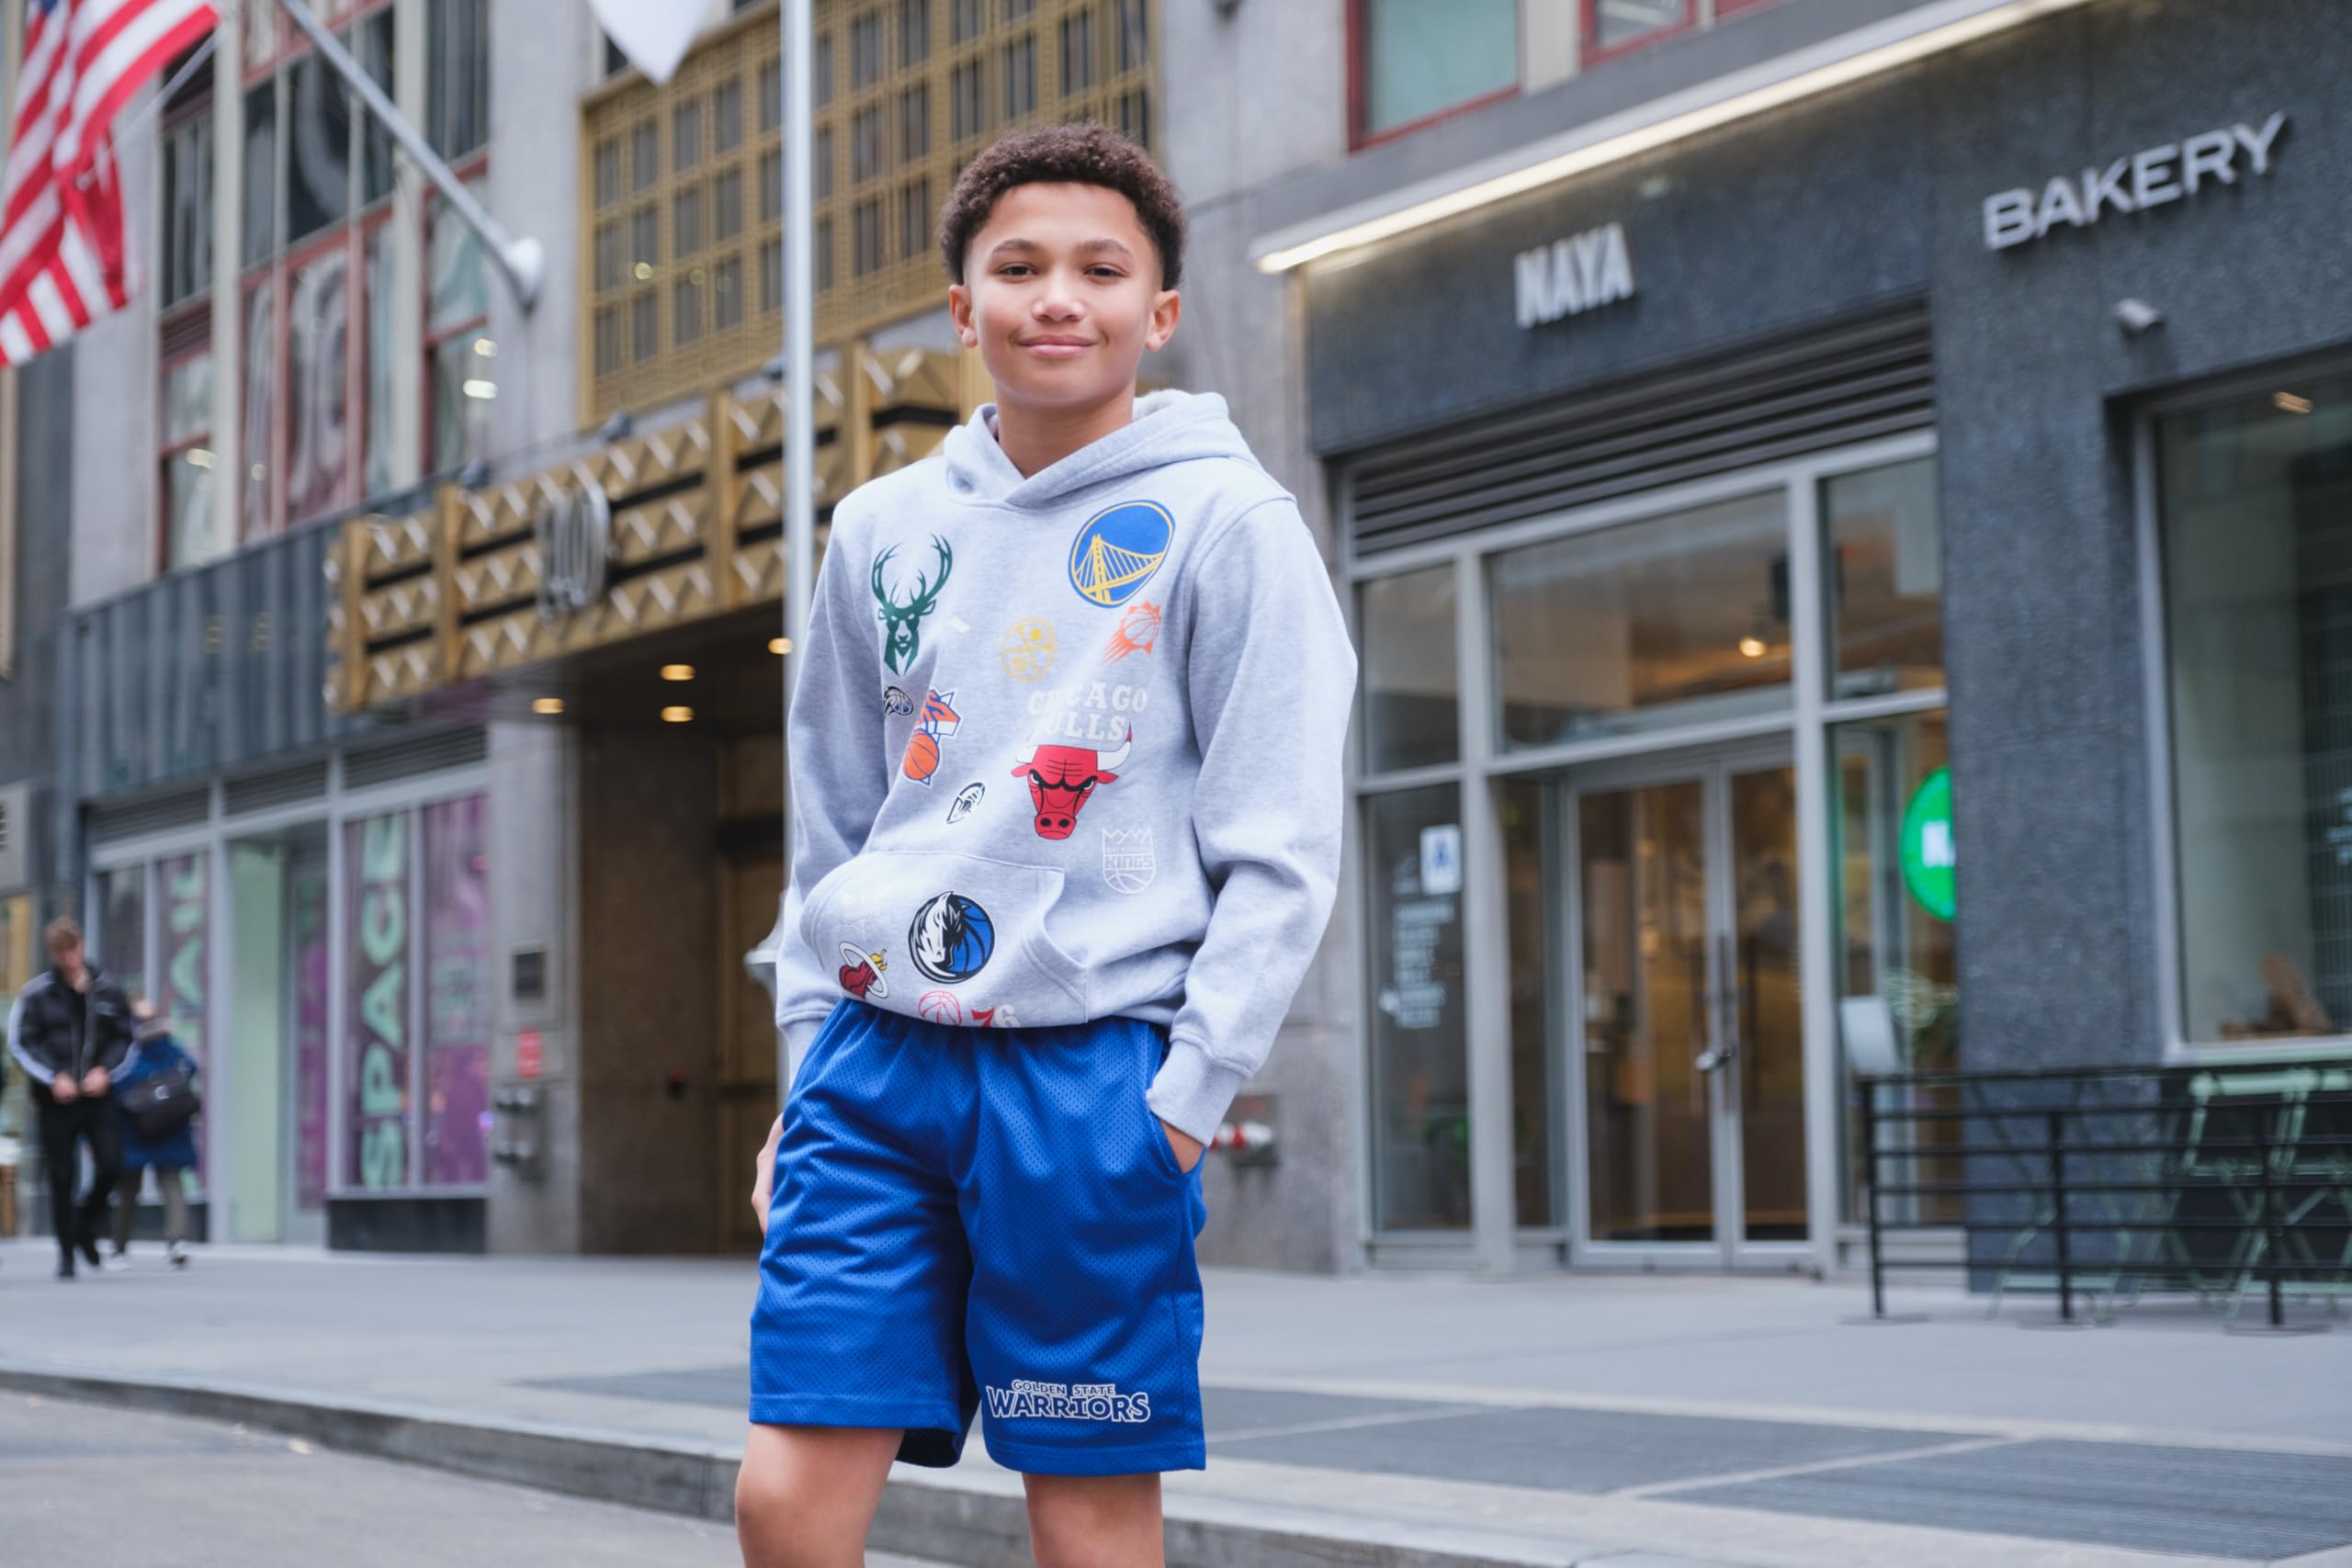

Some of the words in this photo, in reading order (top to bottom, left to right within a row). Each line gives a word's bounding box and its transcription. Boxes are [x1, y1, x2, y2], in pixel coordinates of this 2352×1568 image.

[1982, 110, 2286, 250] BAKERY
[1034, 710, 1126, 742] ULLS
[361, 813, 404, 1190] SPACE
[986, 1386, 1150, 1423] WARRIORS
[1012, 1379, 1067, 1396] GOLDEN
[1072, 1383, 1116, 1397] STATE
